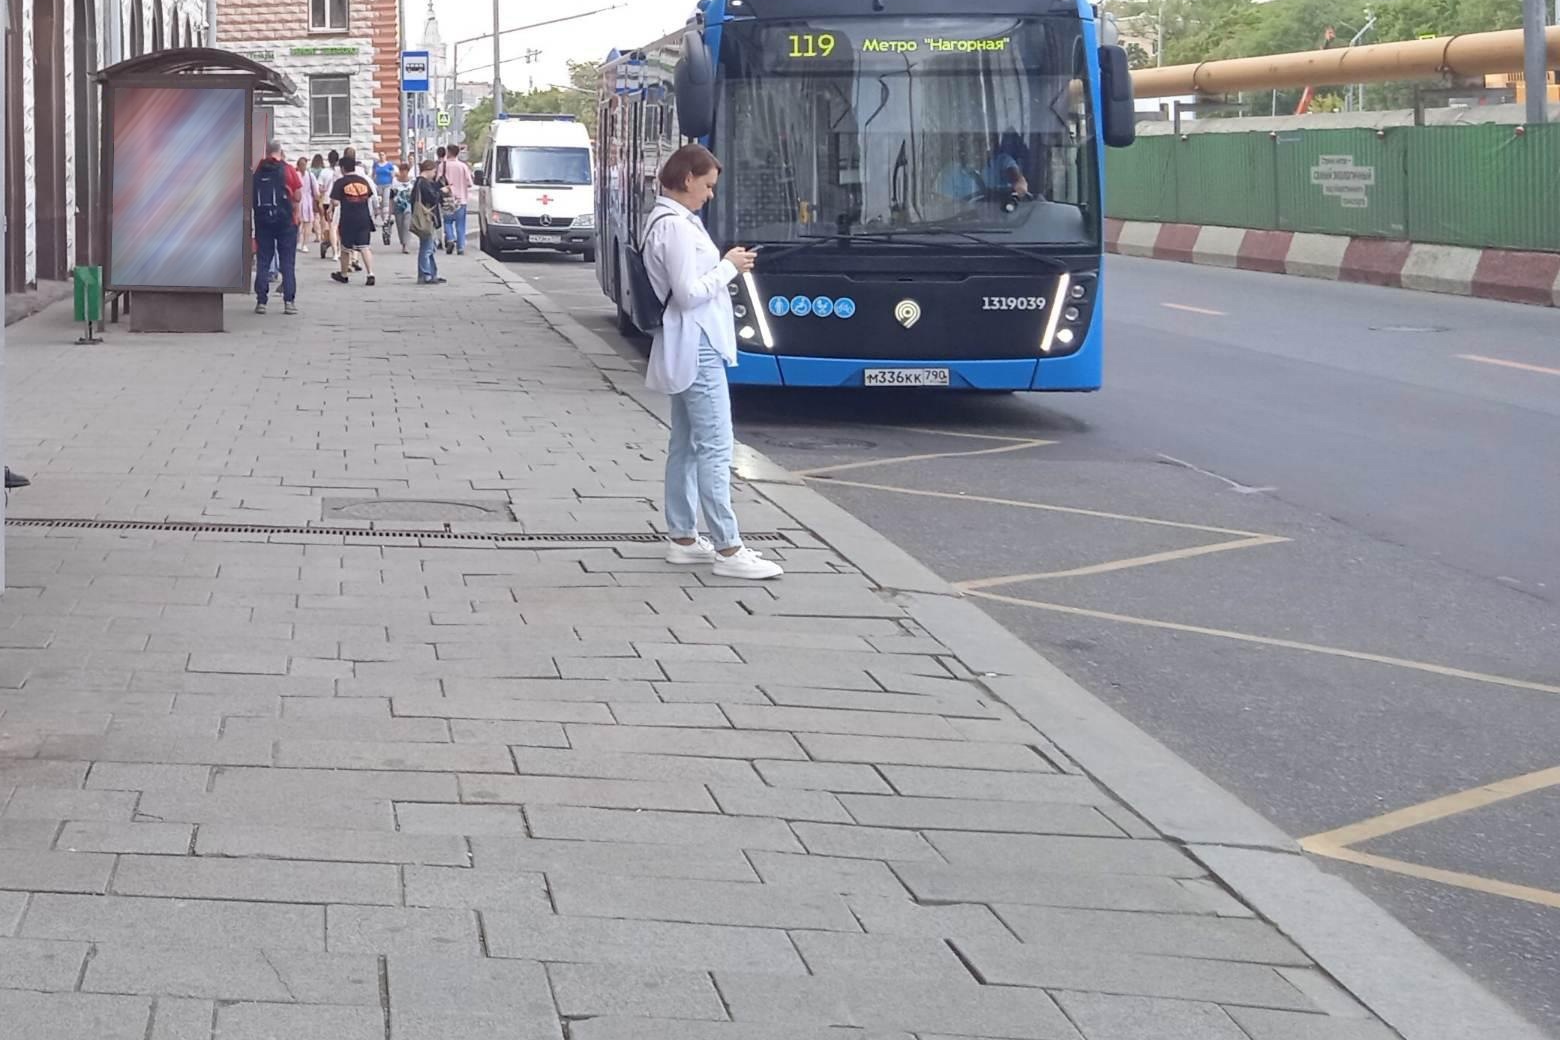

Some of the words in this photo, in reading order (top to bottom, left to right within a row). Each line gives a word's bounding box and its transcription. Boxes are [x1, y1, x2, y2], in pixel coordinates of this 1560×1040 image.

[788, 34, 834, 57] 119
[862, 39, 917, 53] Метро
[924, 38, 1010, 52] "Нагорная"
[982, 296, 1045, 310] 1319039
